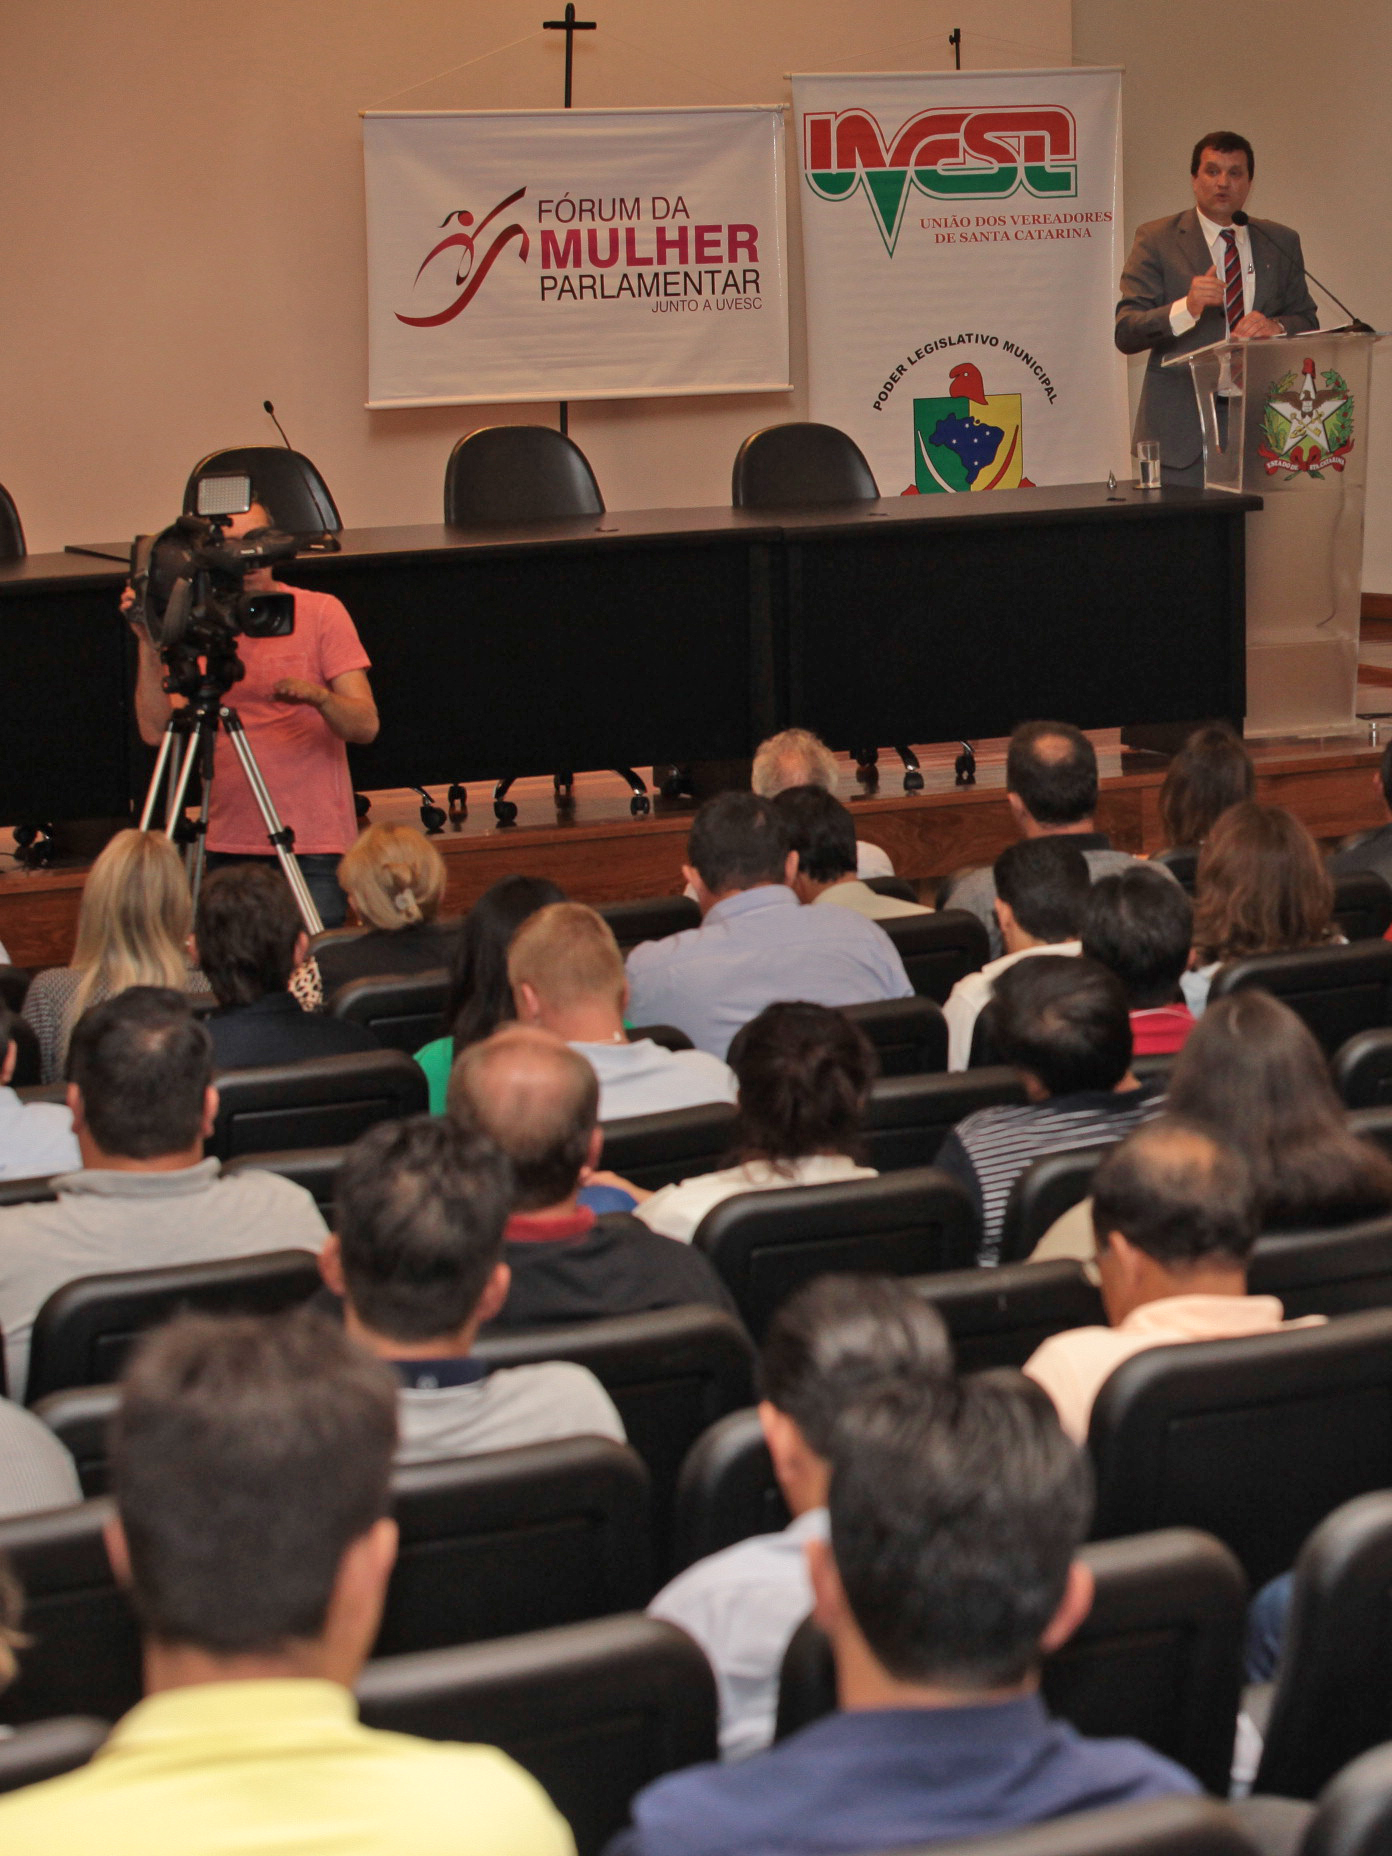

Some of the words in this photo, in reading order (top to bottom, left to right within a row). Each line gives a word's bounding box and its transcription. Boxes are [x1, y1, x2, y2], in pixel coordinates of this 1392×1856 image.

[538, 192, 641, 224] FÓRUM
[651, 196, 690, 220] DA
[920, 215, 971, 229] UNIÃO
[975, 215, 1006, 227] DOS
[1010, 211, 1113, 226] VEREADORES
[540, 223, 760, 269] MULHER
[934, 232, 956, 244] DE
[959, 230, 1011, 243] SANTA
[1014, 227, 1092, 241] CATARINA
[540, 269, 761, 301] PARLAMENTAR
[652, 299, 699, 313] JUNTO
[702, 298, 712, 311] A
[716, 297, 762, 311] UVESC
[872, 364, 908, 412] PODER
[907, 333, 999, 366] LEGISLATIVO
[1002, 340, 1060, 405] MUNICIPAL
